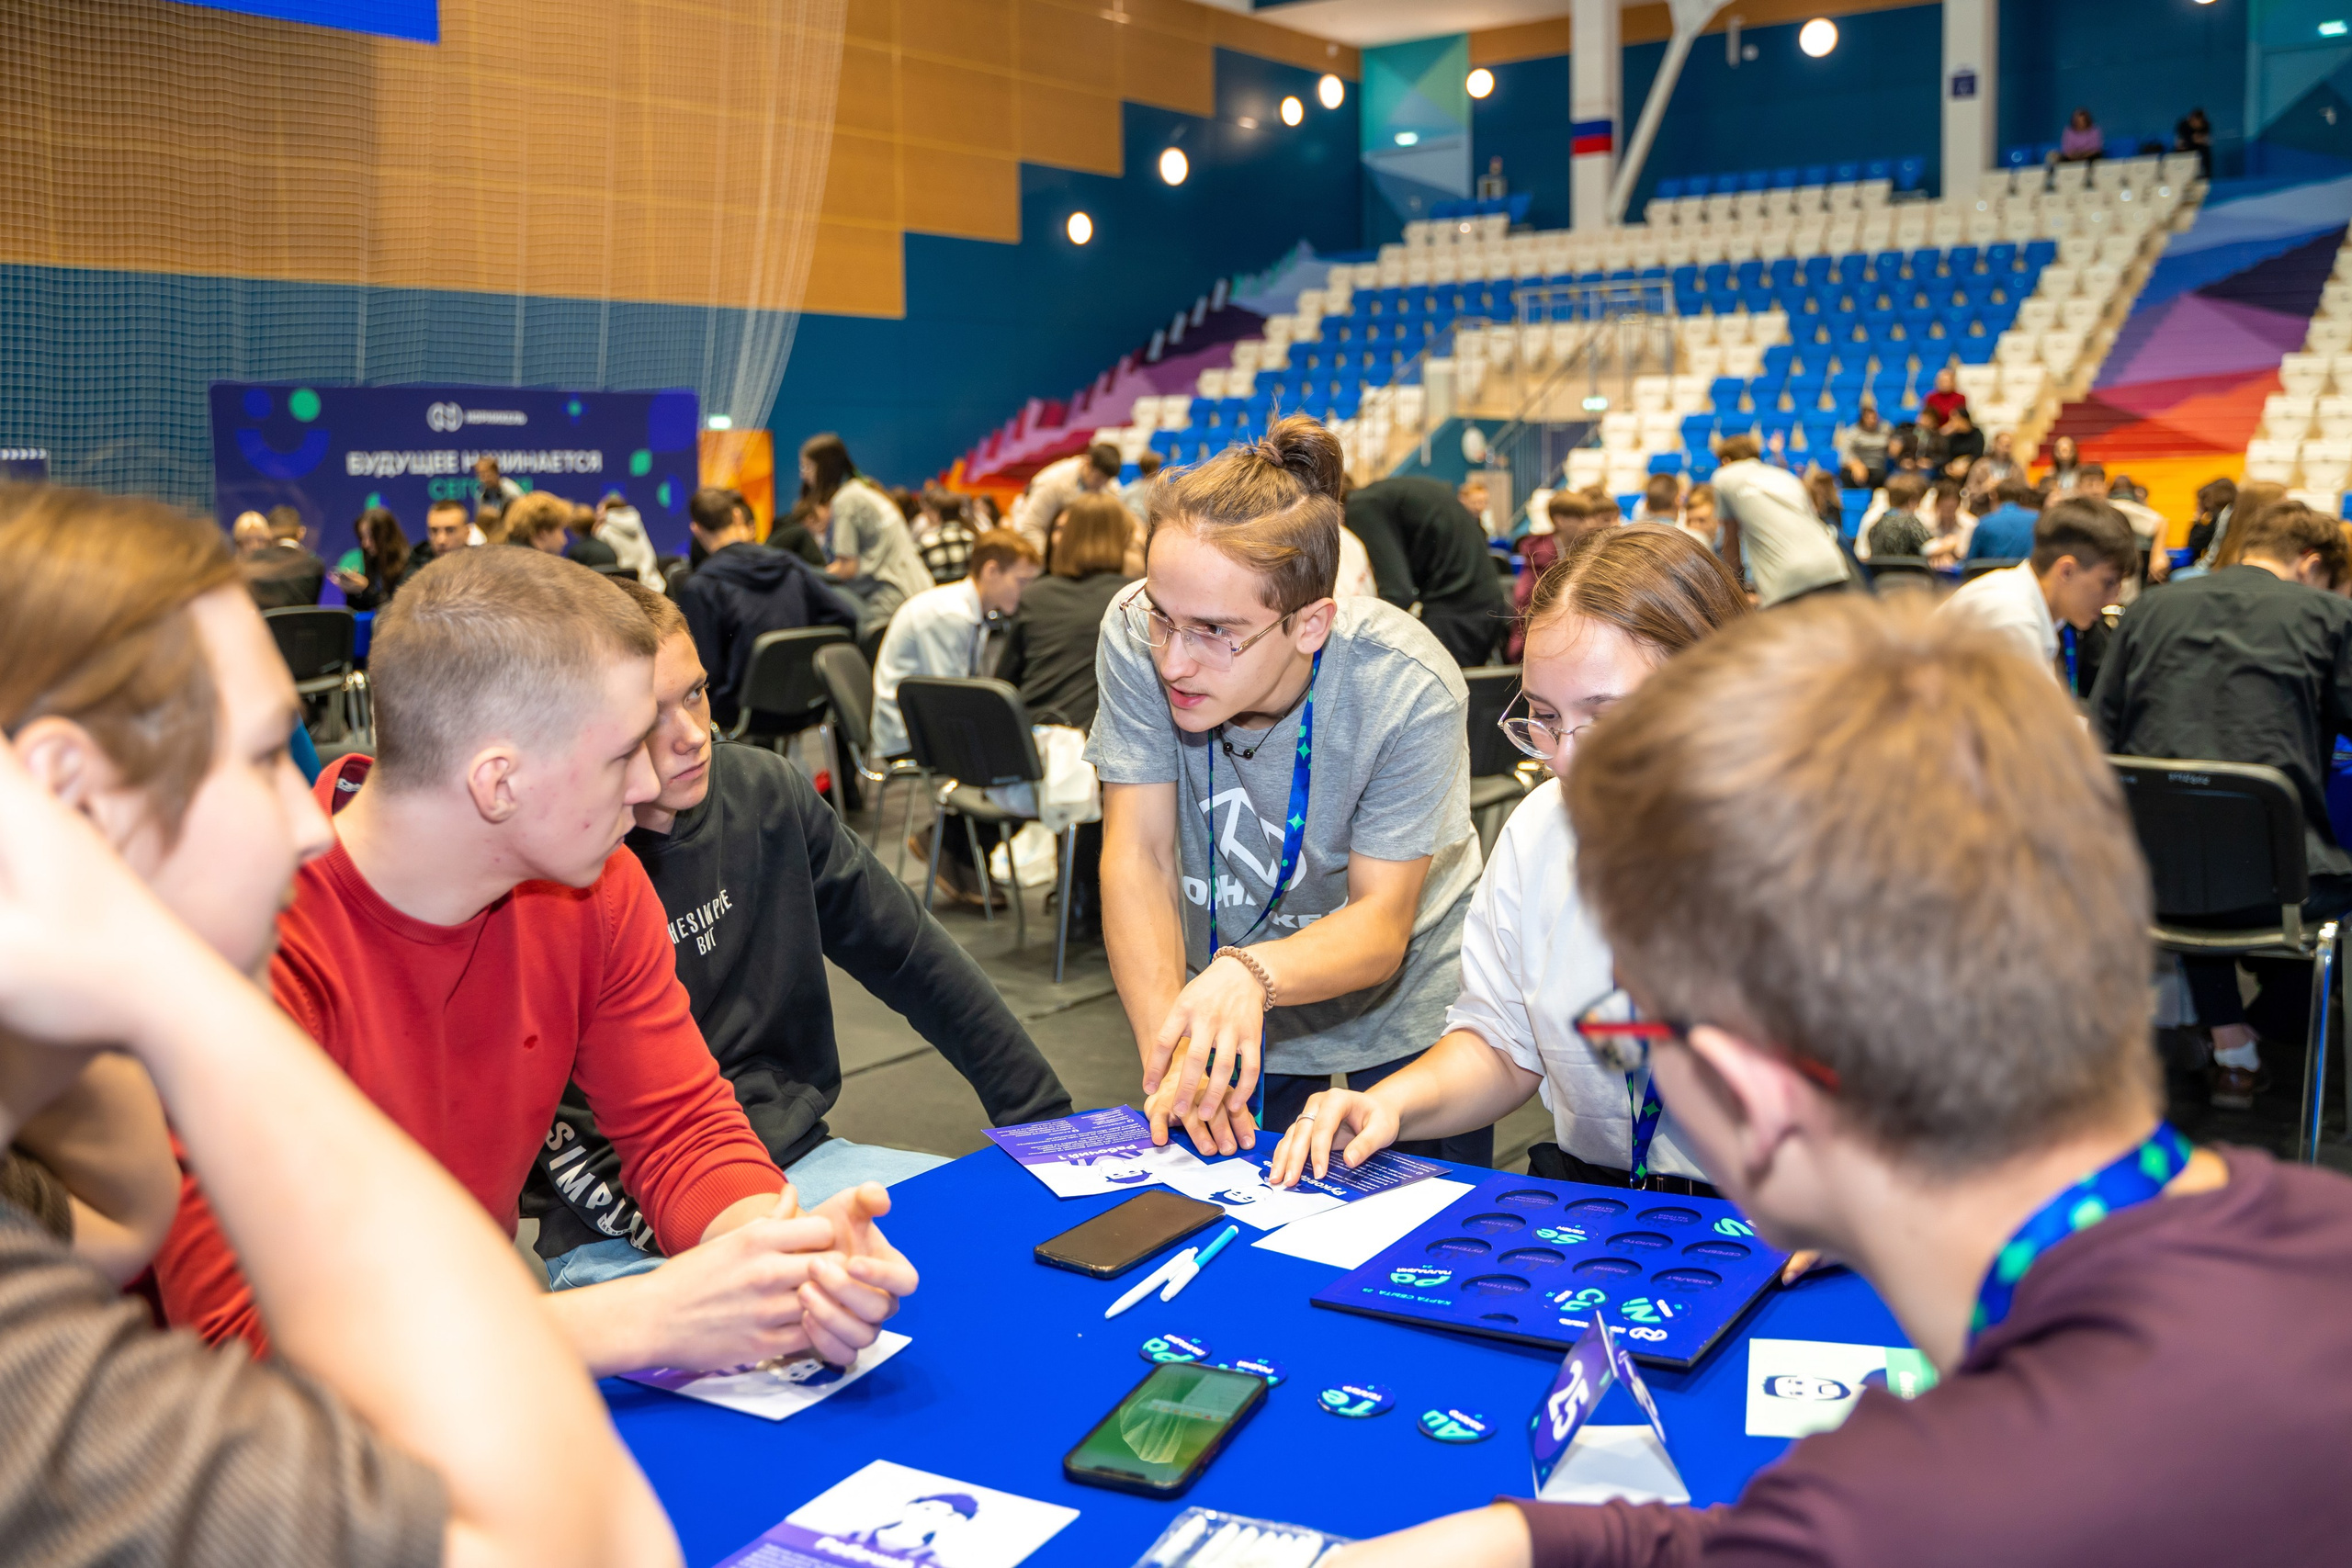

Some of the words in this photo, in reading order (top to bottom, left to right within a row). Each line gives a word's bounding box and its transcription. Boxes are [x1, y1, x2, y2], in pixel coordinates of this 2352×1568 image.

[345, 450, 459, 478] БУДУЩЕЕ
[1068, 1145, 1137, 1158] Рабочий
[1480, 1220, 1513, 1228] ТЕЛЛУР
[1536, 1228, 1588, 1245] Se
[1442, 1244, 1485, 1254] РУТЕНИЙ
[1623, 1239, 1663, 1247] ЗОЛОТО
[1697, 1248, 1741, 1257] СЕРЕБРО
[1515, 1254, 1555, 1264] ИРИДИЙ
[1593, 1265, 1629, 1274] РОДИЙ
[1390, 1272, 1451, 1287] Pd
[1666, 1275, 1713, 1285] КОБАЛЬТ
[1477, 1280, 1523, 1292] ПЛАТИНА
[1378, 1290, 1415, 1300] СБЫТА
[1417, 1296, 1452, 1306] КАРТА
[1559, 1288, 1606, 1312] Cu
[1622, 1297, 1662, 1323] Ni
[1322, 1389, 1375, 1416] Te
[1548, 1359, 1589, 1441] 25
[1422, 1409, 1479, 1439] Au
